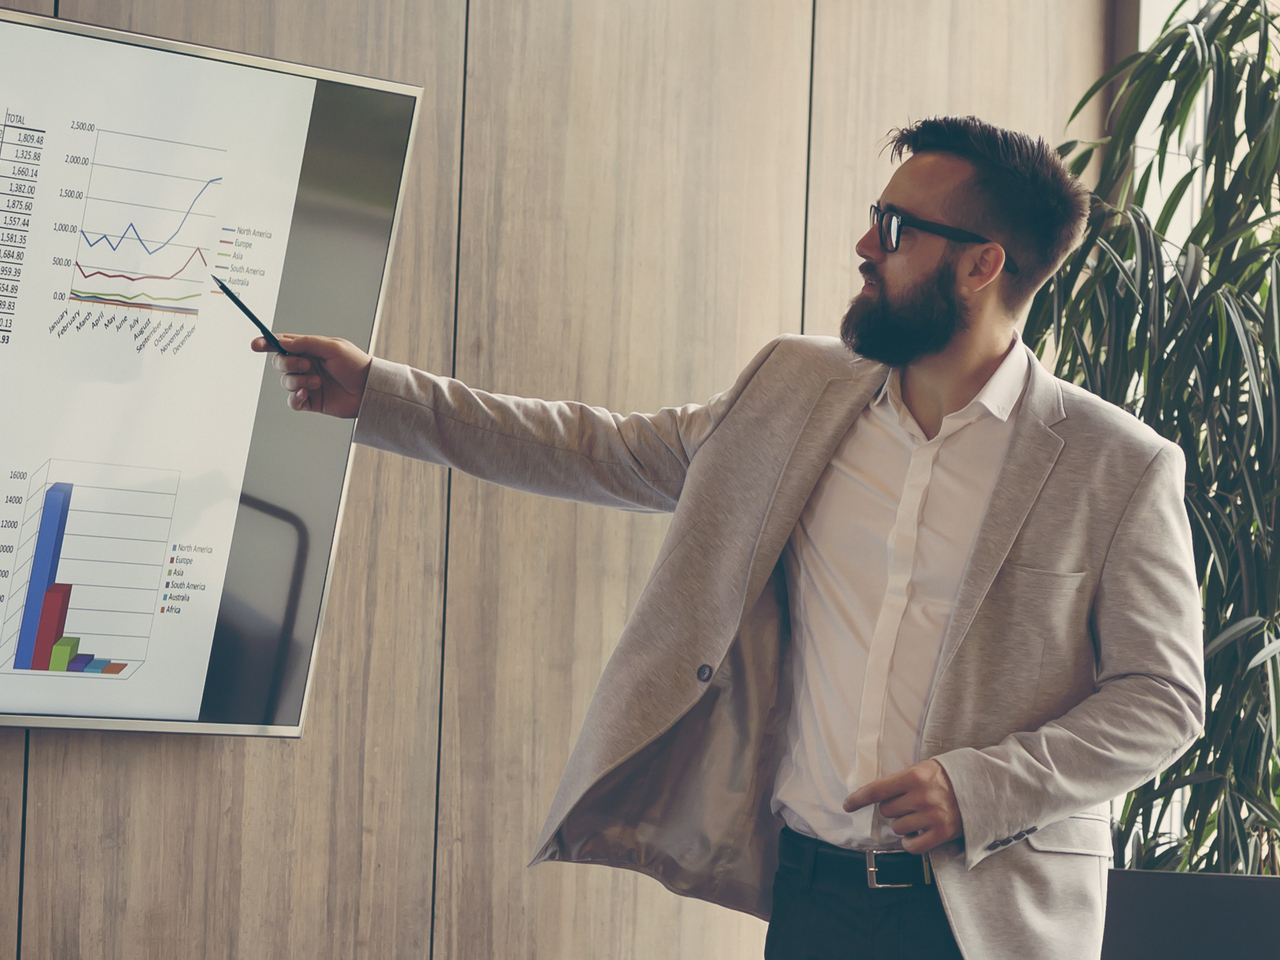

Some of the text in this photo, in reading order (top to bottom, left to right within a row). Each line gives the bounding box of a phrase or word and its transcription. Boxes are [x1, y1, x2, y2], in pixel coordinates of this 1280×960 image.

[7, 113, 25, 124] TOTAL
[71, 121, 95, 131] 2,500.00
[18, 133, 43, 145] 1,809.48
[15, 150, 41, 161] 1,325.88
[65, 155, 89, 165] 2,000.00
[12, 166, 38, 178] 1,660.14
[10, 183, 35, 194] 1,382.00
[60, 189, 83, 199] 1,500.00
[7, 200, 32, 211] 1,875.60
[4, 216, 29, 227] 1,557.44
[54, 223, 77, 233] 1,000.00
[1, 233, 27, 244] 1,581.35
[52, 257, 71, 267] 500.00
[54, 292, 65, 301] 0.00
[10, 471, 27, 480] 16000
[5, 496, 23, 504] 14000
[1, 520, 18, 529] 12000
[176, 557, 193, 565] Europe
[168, 594, 190, 602] Australia
[166, 606, 180, 614] Africa
